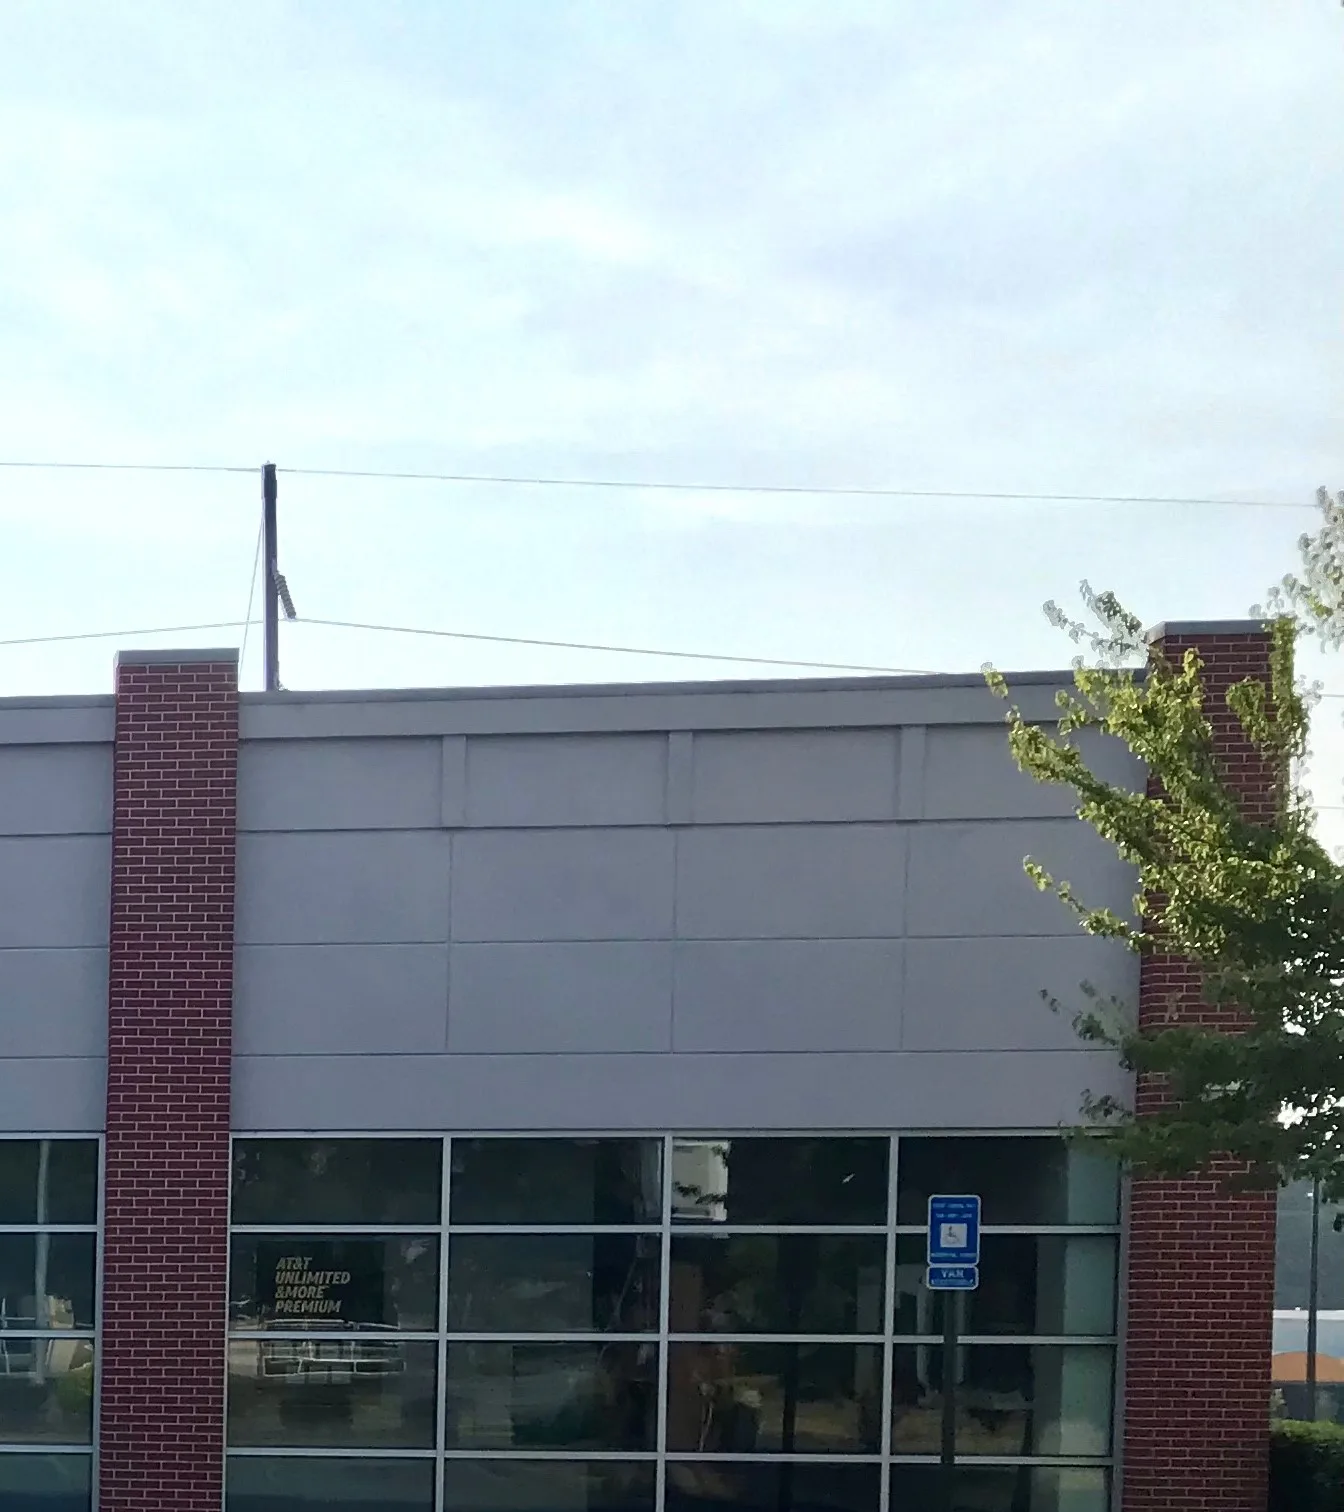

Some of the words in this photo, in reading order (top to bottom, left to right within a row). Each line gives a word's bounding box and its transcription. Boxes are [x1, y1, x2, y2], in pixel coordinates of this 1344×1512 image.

[275, 1256, 312, 1270] AT&T
[275, 1271, 351, 1284] UNLIMITED
[275, 1285, 326, 1299] &MORE
[275, 1299, 342, 1313] PREMIUM
